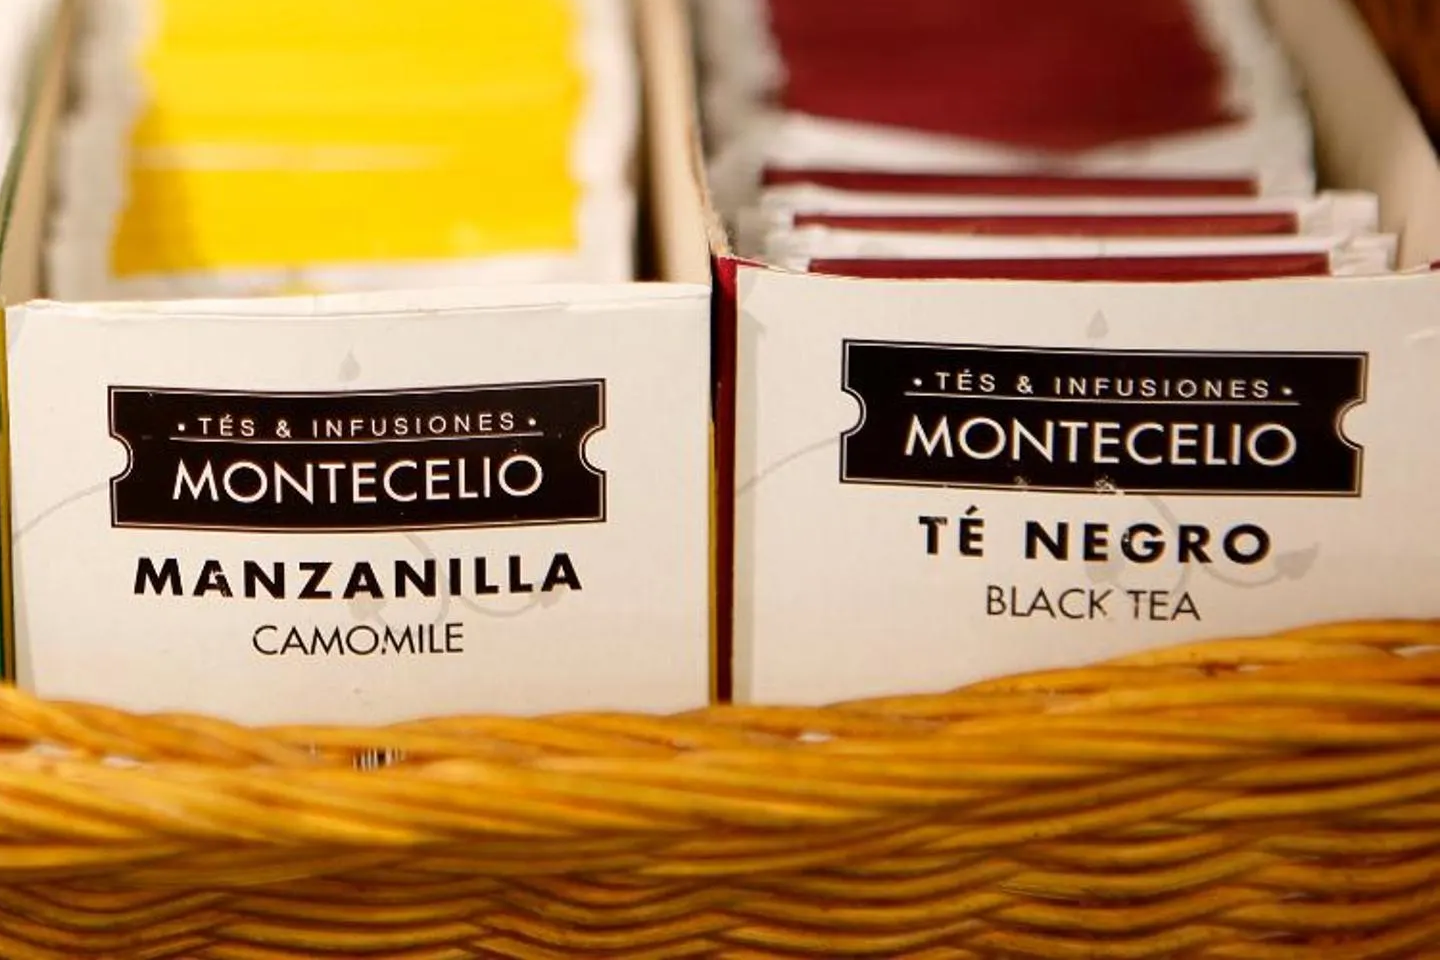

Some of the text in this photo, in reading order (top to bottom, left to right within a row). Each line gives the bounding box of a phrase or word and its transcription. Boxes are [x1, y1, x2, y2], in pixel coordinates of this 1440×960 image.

[935, 368, 1270, 400] TÉS & INFUSIONES
[197, 412, 516, 439] TÉS & INFUSIONES
[904, 414, 1297, 467] MONTECELIO
[172, 454, 544, 505] MONTECELIO
[918, 504, 1271, 566] TÉ NEGRO
[133, 552, 583, 600] MANZANILLA
[985, 585, 1201, 622] BLACK TEA
[252, 621, 464, 656] CAMOMILE
